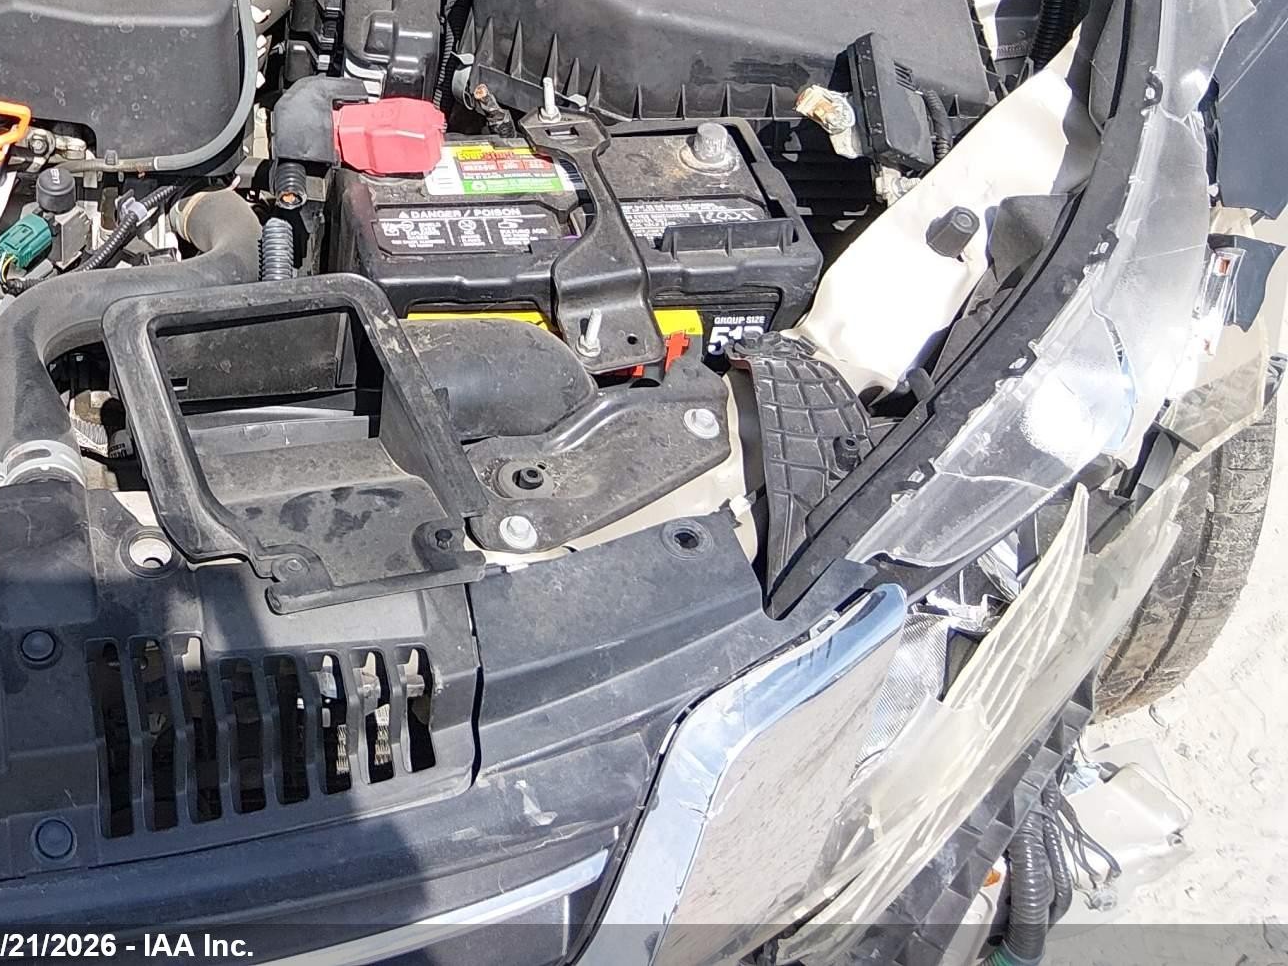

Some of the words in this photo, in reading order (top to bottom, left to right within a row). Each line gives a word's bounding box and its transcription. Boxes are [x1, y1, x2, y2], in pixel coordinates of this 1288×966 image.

[410, 210, 462, 219] DANGER
[474, 208, 522, 217] POISON
[746, 316, 765, 324] SIZE
